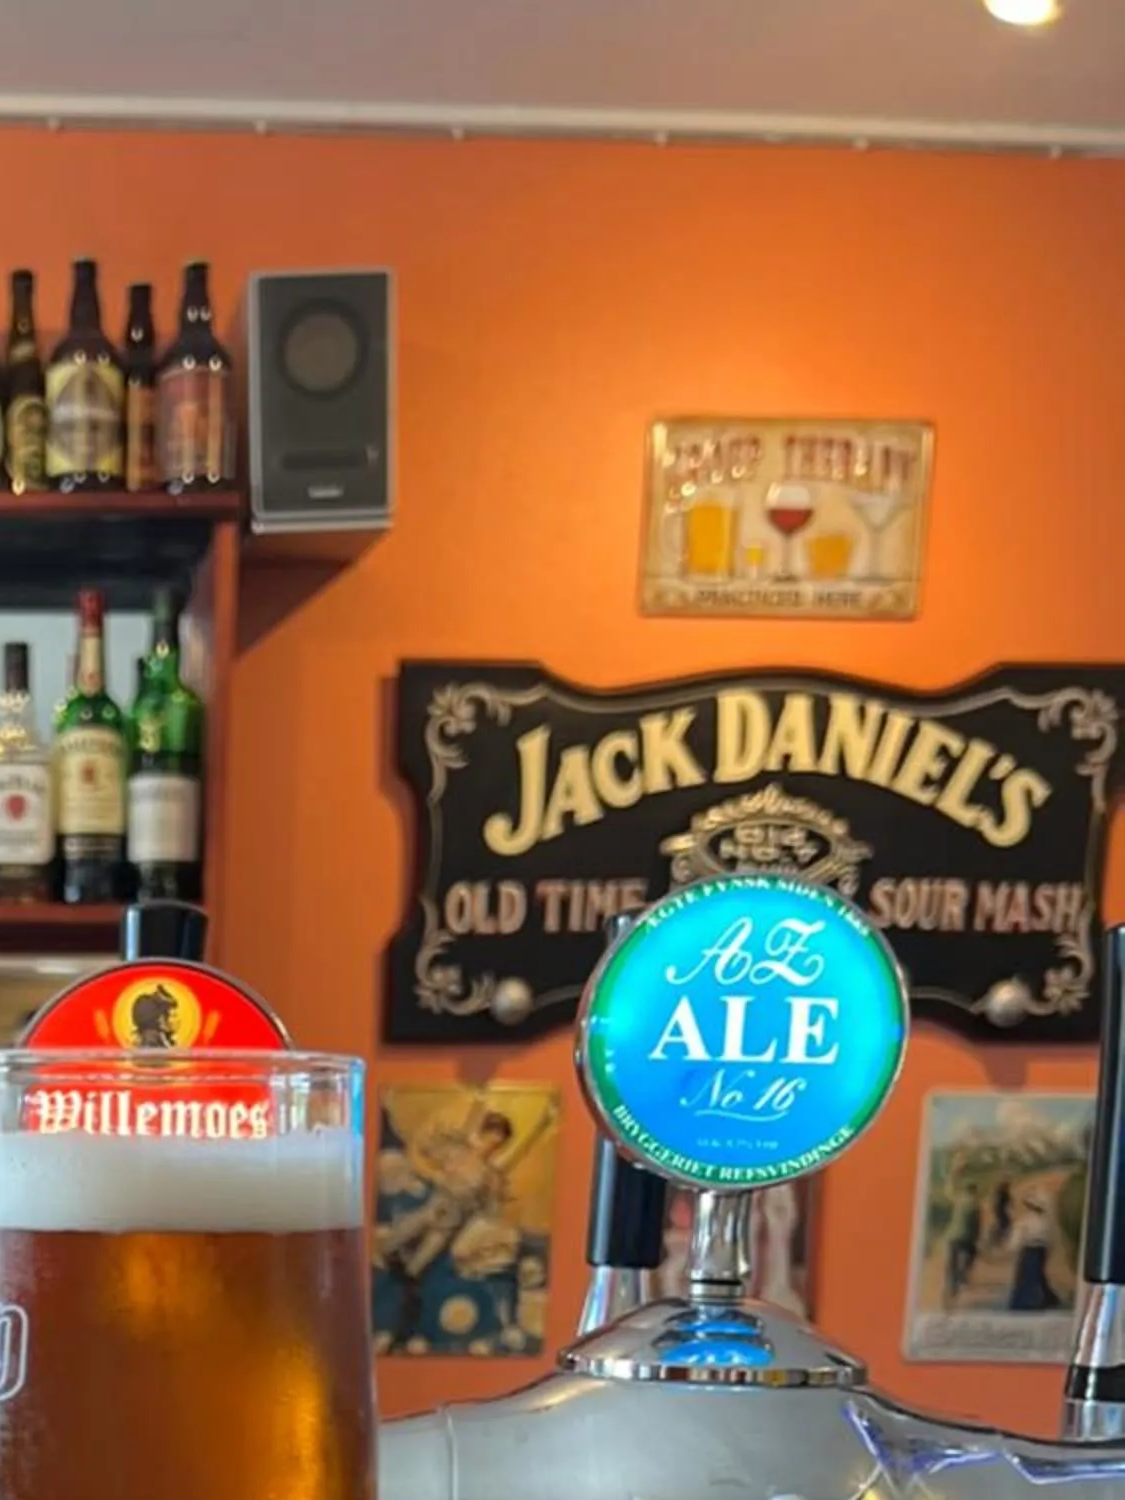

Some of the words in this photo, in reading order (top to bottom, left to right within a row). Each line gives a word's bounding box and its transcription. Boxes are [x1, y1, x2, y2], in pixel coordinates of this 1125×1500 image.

[484, 706, 707, 856] JACK
[715, 689, 1053, 849] DANIEL'S
[445, 878, 527, 935] OLD
[535, 877, 650, 934] TIME
[869, 876, 968, 931] SOUR
[973, 878, 1083, 933] MASH
[648, 995, 840, 1065] ALE
[28, 1089, 269, 1139] Willemoes
[753, 1077, 807, 1111] 16
[612, 1105, 717, 1178] BRYGGERIET
[718, 1124, 856, 1180] REFSVINDINGE
